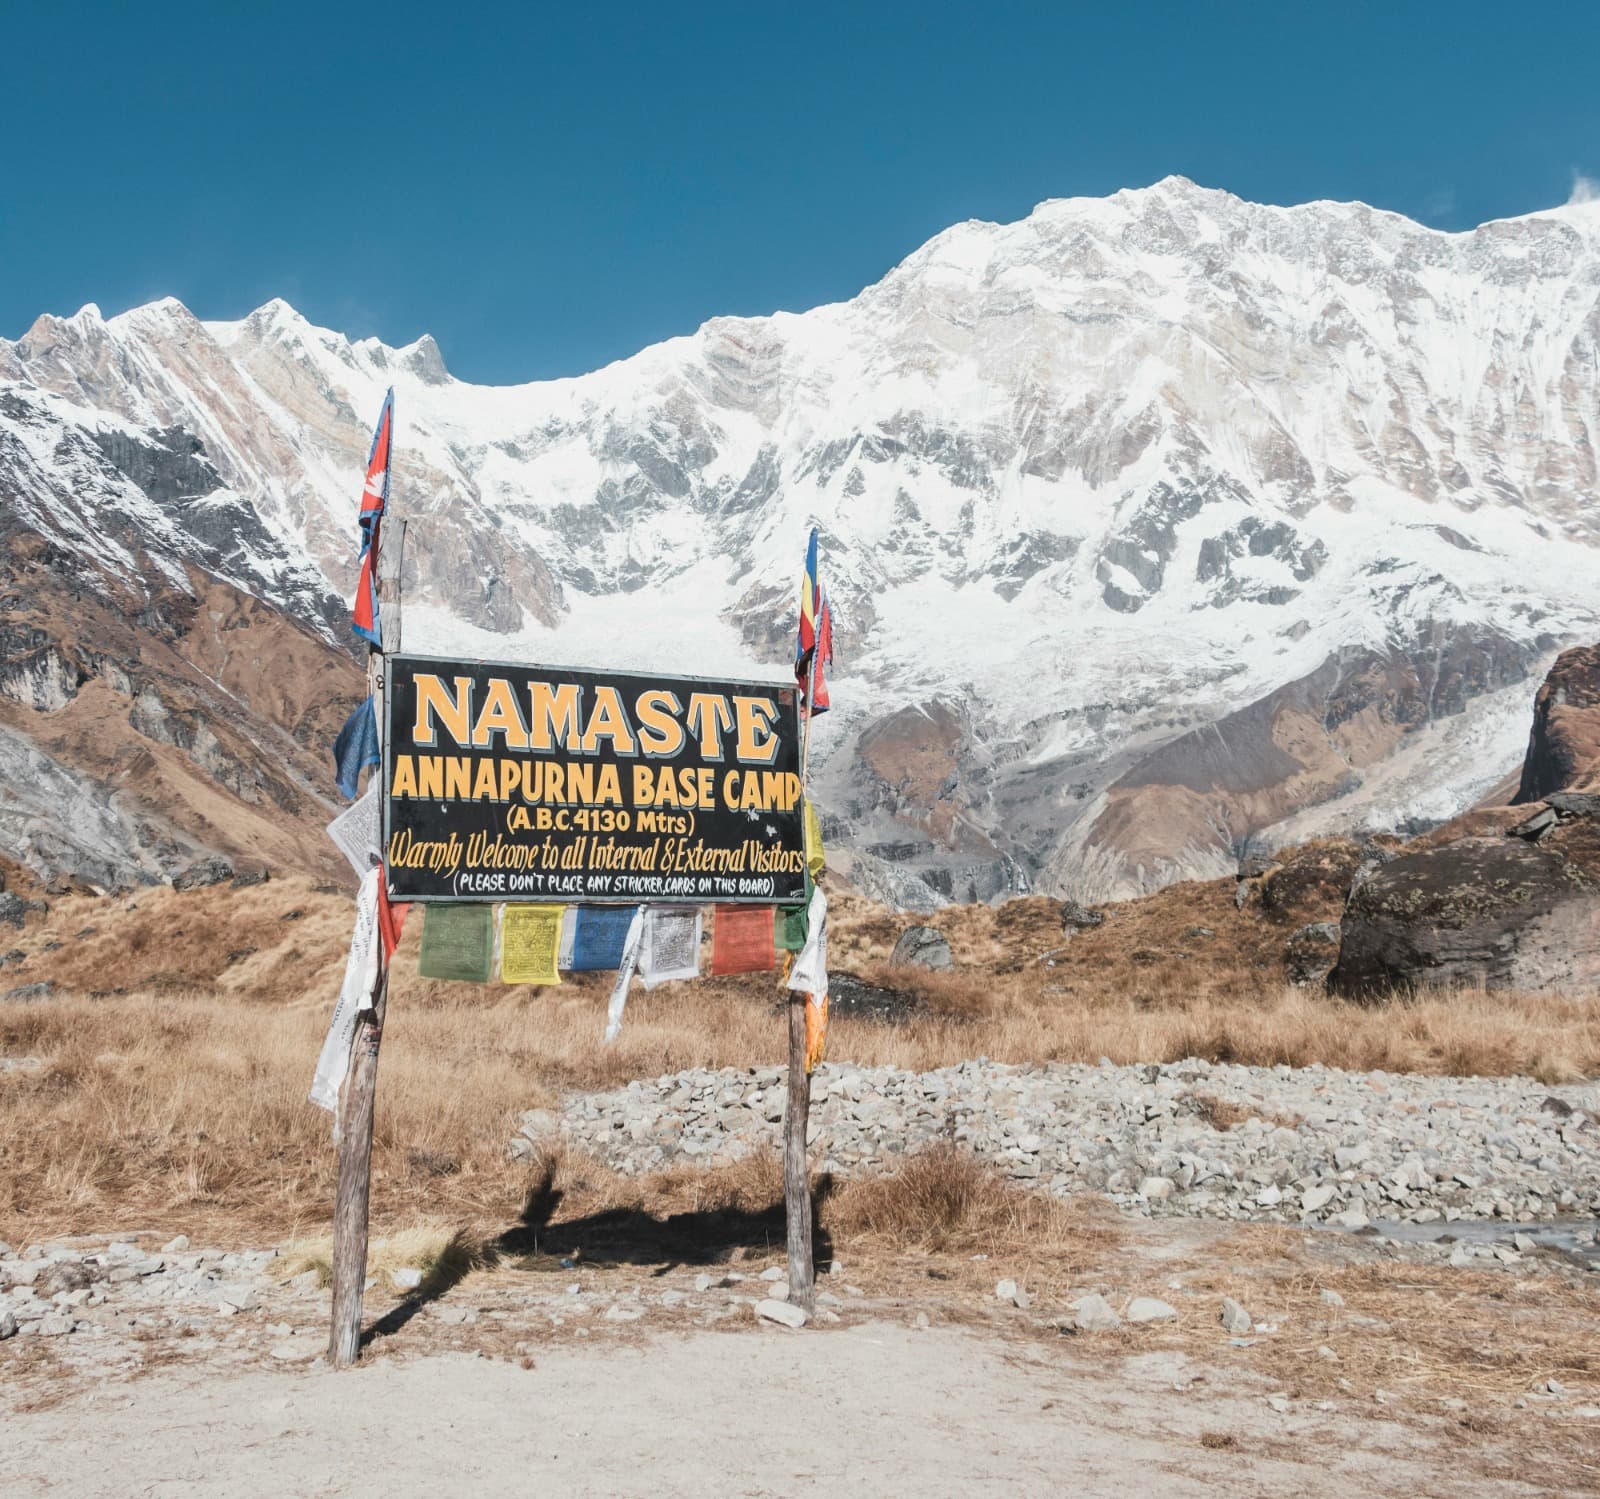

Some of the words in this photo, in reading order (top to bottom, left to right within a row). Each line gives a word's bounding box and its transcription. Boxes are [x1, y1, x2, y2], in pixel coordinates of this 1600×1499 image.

[412, 673, 781, 765] NAMASTE
[391, 755, 623, 807] ANNAPURNA
[633, 765, 715, 811] BASE
[723, 769, 801, 815] CAMP
[636, 810, 695, 837] Mtrs)
[389, 828, 463, 878] Warmly
[466, 830, 539, 874] Welcome
[542, 834, 559, 869] to
[561, 836, 587, 870] all
[589, 836, 660, 872] Internal
[749, 840, 804, 873] Visitors
[453, 870, 505, 896] (PLEASE
[509, 872, 544, 893] DON'T
[548, 875, 585, 896] PLACE
[587, 876, 612, 893] ANY
[699, 879, 713, 893] ON
[714, 877, 736, 894] THIS
[739, 877, 775, 897] BOARD)
